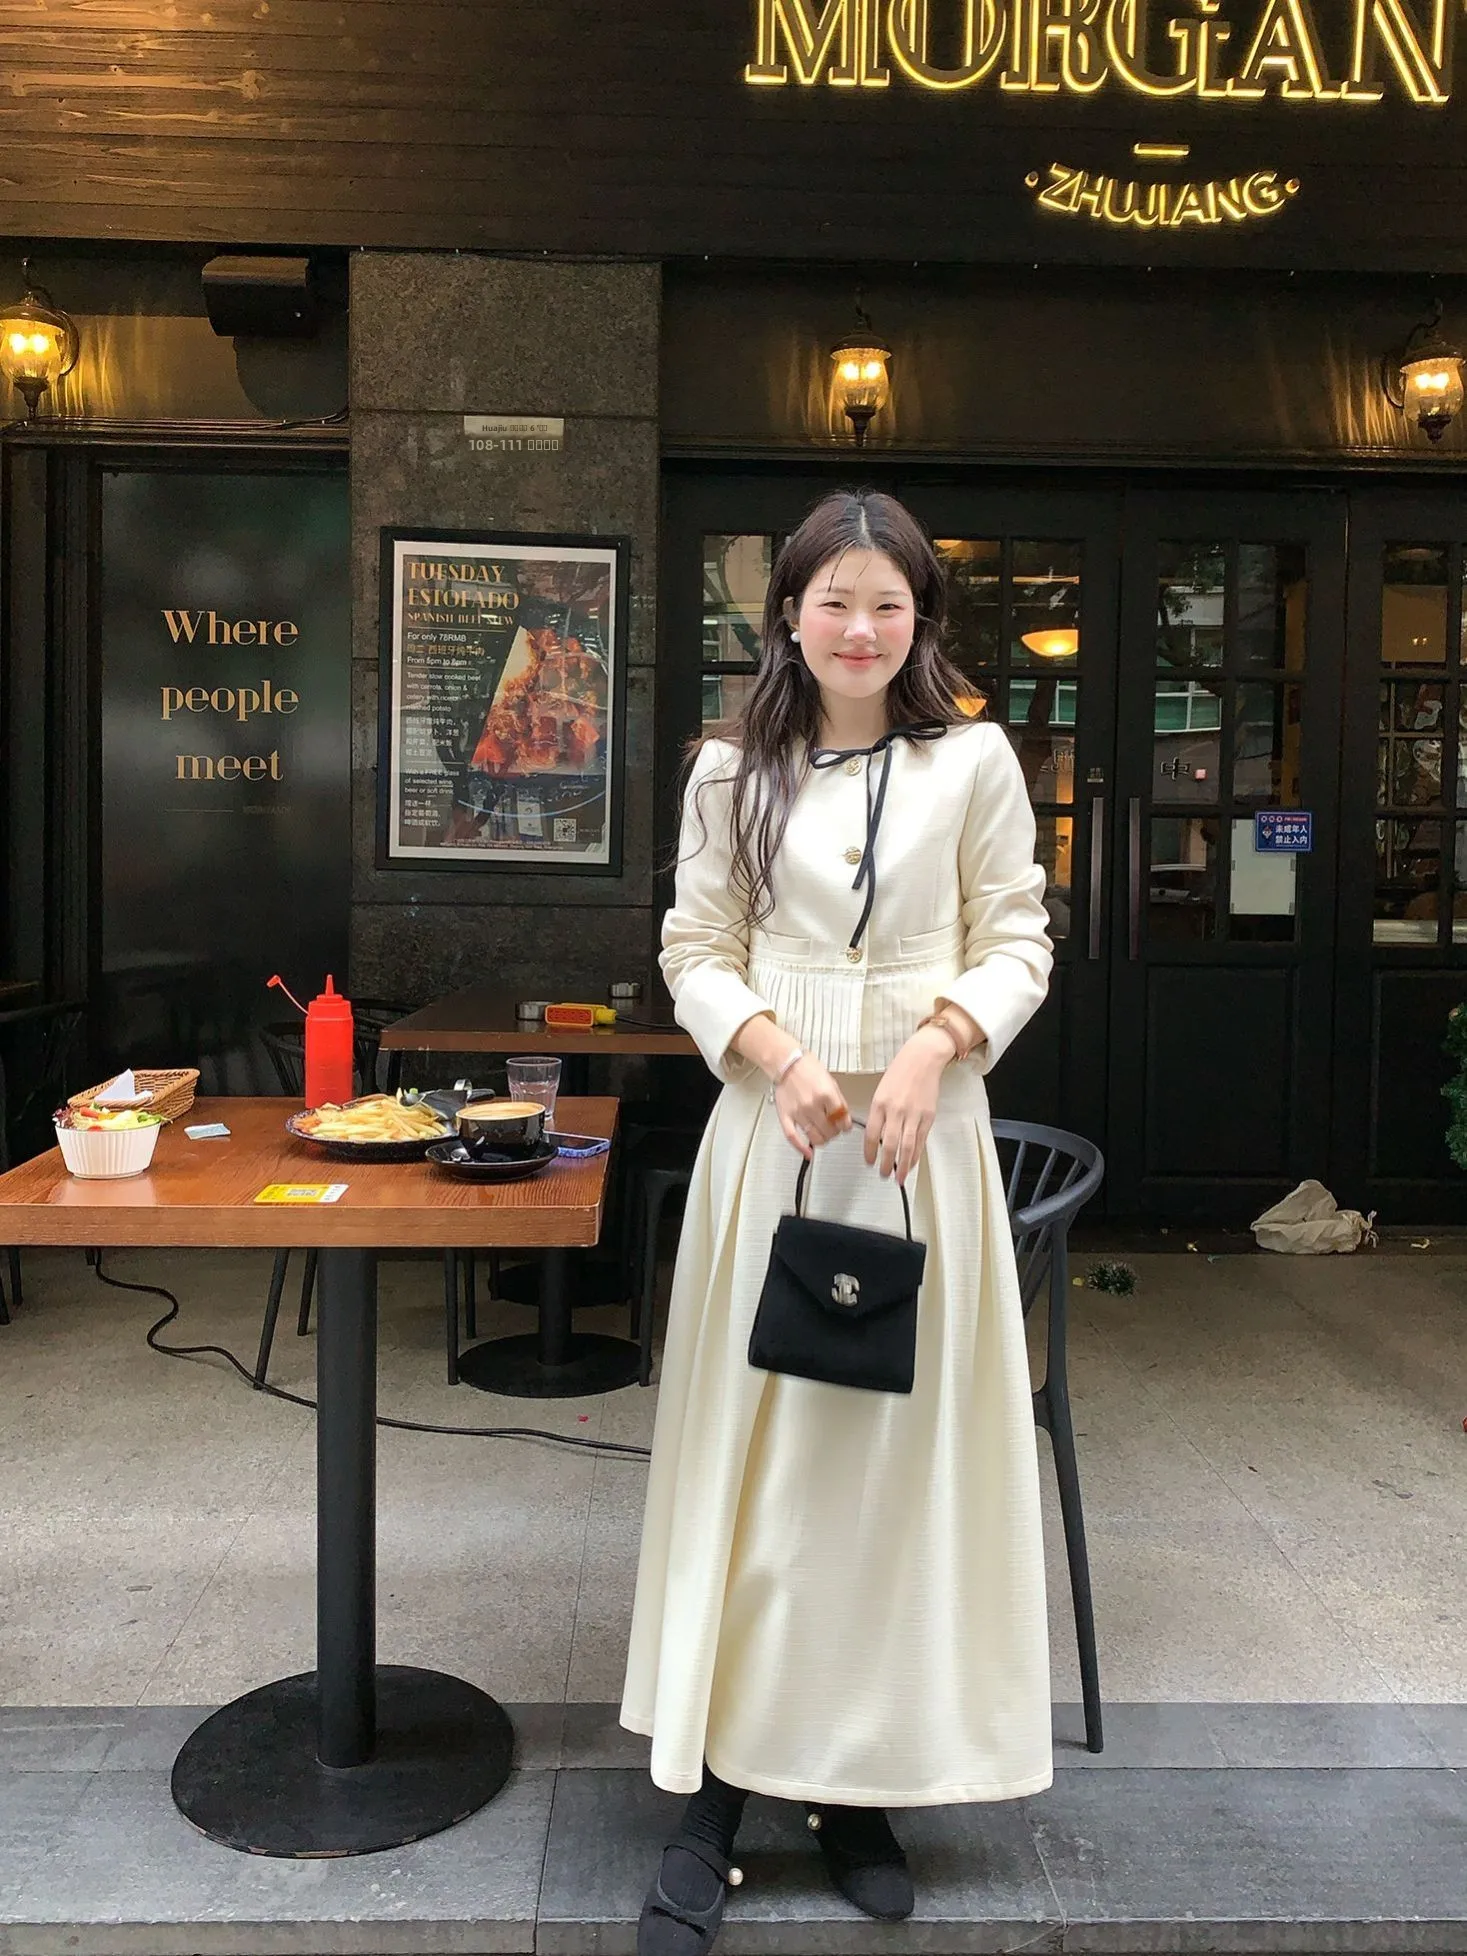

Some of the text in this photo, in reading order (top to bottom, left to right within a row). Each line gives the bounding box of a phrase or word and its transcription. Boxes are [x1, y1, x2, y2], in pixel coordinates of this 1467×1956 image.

[1038, 162, 1285, 227] ZHUJIANG
[469, 440, 522, 451] 108-111
[407, 562, 504, 583] TUESDAY
[408, 587, 520, 610] ESTOFADO
[161, 609, 299, 646] Where
[407, 632, 420, 640] For
[421, 633, 437, 642] only
[407, 656, 425, 664] From
[444, 673, 466, 681] cooked
[160, 680, 299, 722] people
[175, 749, 285, 781] meet
[1275, 824, 1308, 834] 未成年人
[1275, 835, 1308, 845] 禁止入内
